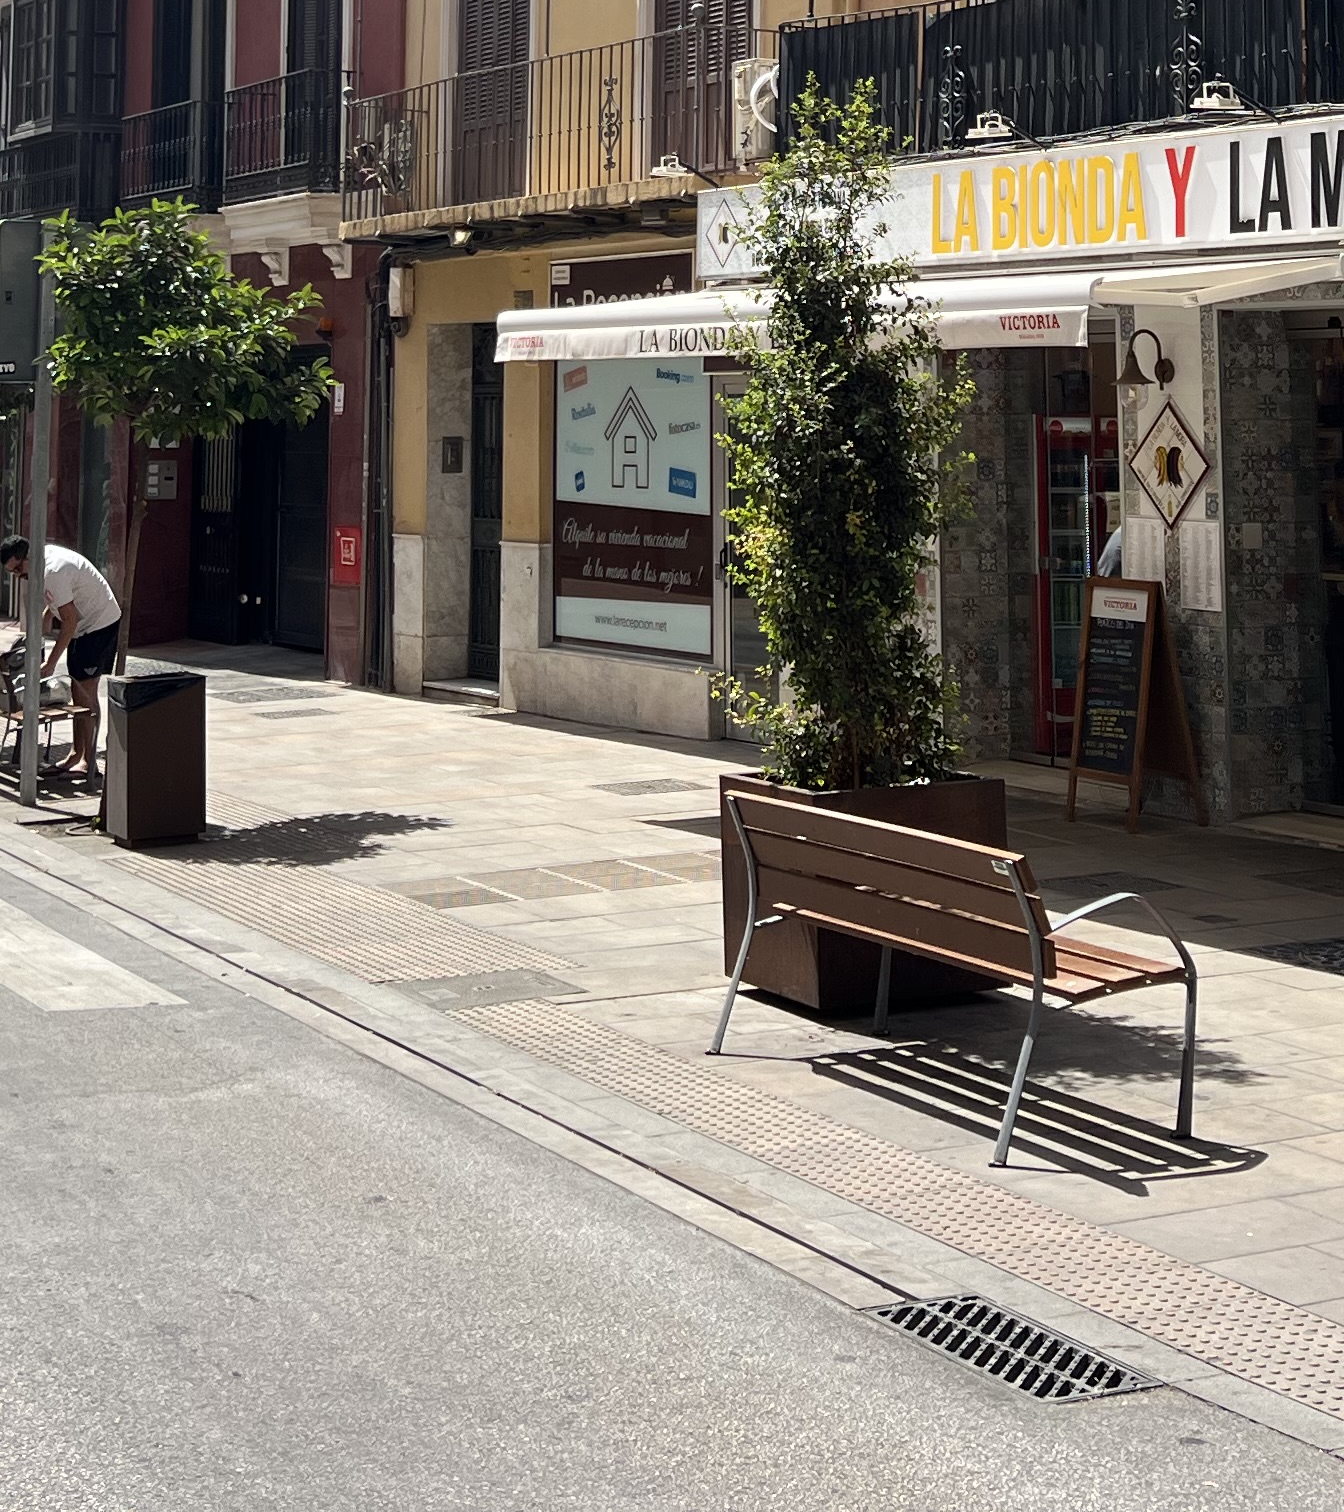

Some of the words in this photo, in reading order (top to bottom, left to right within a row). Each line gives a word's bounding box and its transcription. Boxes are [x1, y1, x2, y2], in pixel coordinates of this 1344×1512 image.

[931, 170, 978, 254] LA
[992, 152, 1147, 250] BIONDA
[1165, 146, 1196, 238] Y
[1229, 136, 1292, 234] LA
[999, 314, 1060, 330] VICTORIA
[510, 336, 544, 349] VICTORIA
[639, 329, 660, 352] LA
[669, 326, 730, 352] BIOND
[563, 518, 594, 549] Alquile
[608, 526, 640, 546] vivienda
[644, 529, 690, 549] vacacional
[583, 557, 592, 576] de
[595, 558, 604, 578] la
[606, 566, 628, 580] mano
[631, 561, 641, 581] de
[644, 561, 657, 582] los
[659, 570, 692, 593] mejores
[1104, 599, 1137, 610] VICTORIA
[594, 614, 668, 632] www.larecepcion.net
